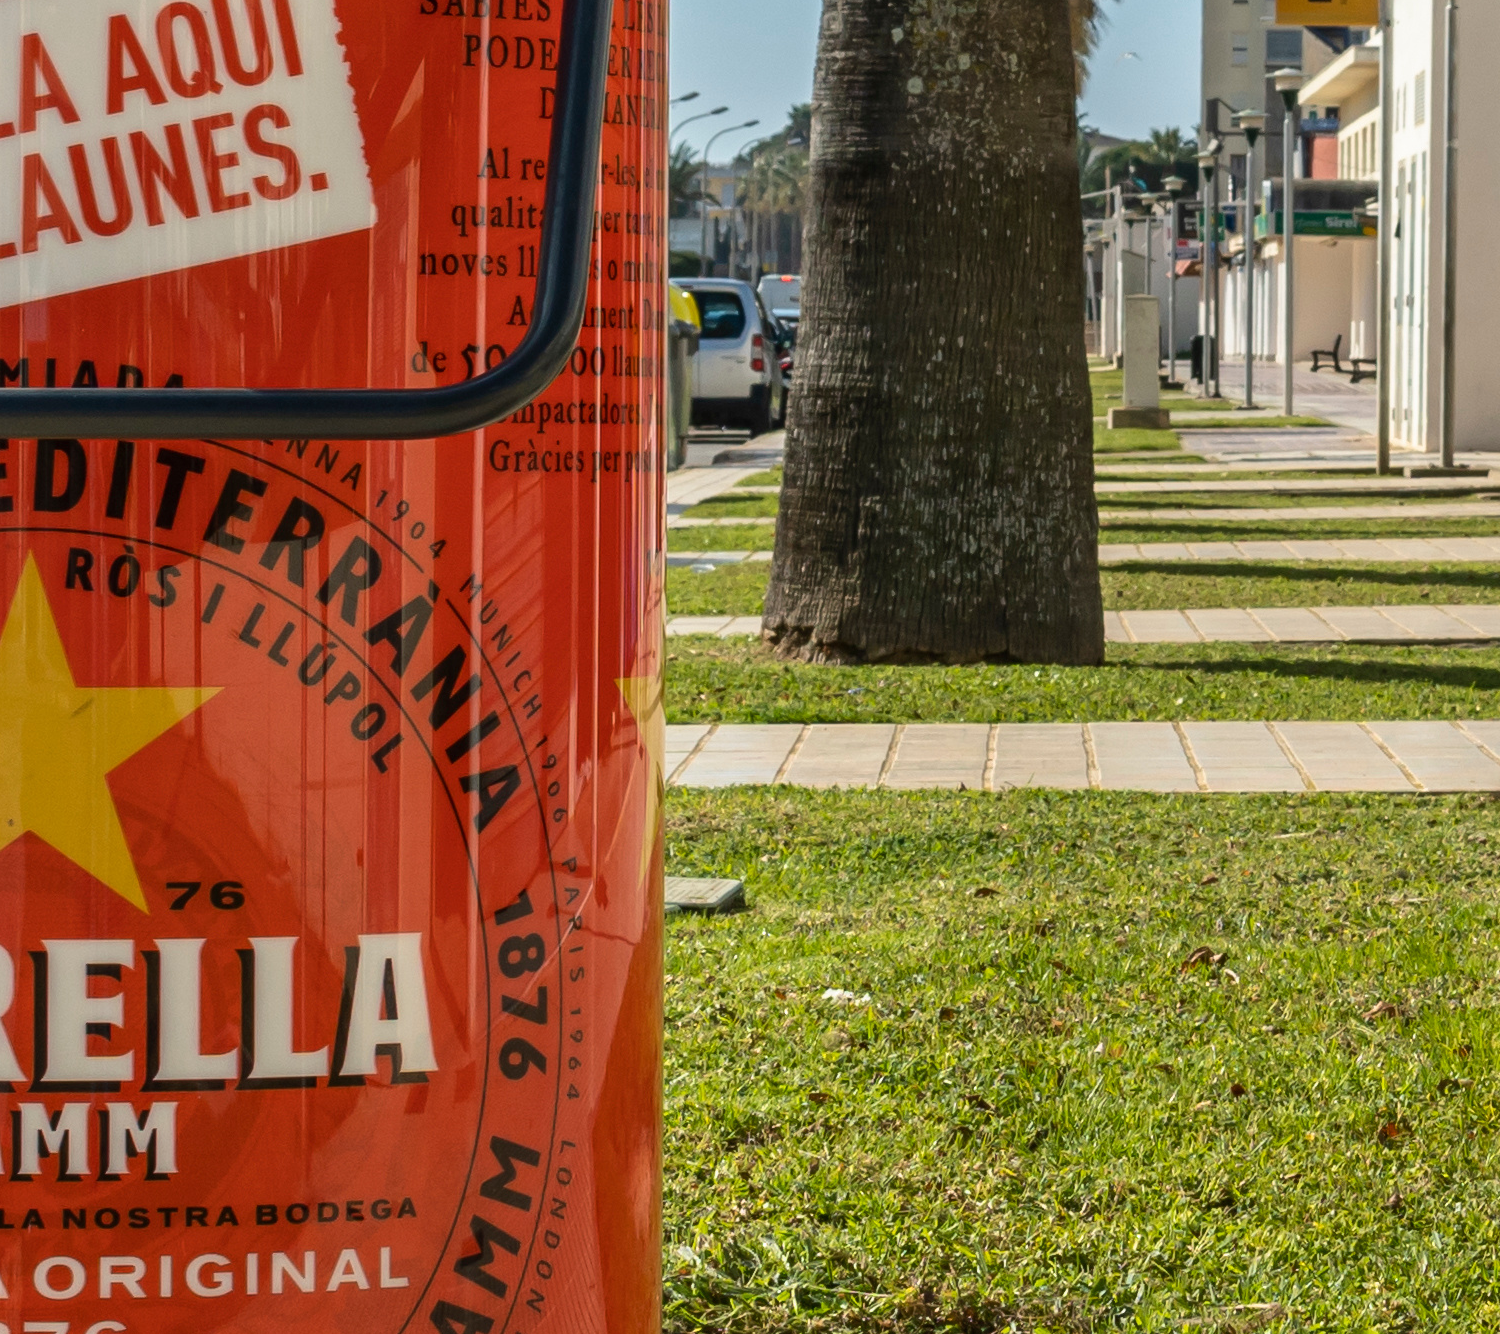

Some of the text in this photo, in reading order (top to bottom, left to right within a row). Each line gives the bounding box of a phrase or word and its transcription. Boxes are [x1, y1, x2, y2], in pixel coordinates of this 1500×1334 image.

[476, 147, 511, 180] Al
[419, 251, 508, 277] noves
[411, 341, 447, 374] de
[489, 439, 584, 473] Gràcies
[373, 488, 449, 561] 1904
[65, 543, 183, 609] RÒS
[201, 582, 226, 625] I
[237, 601, 406, 774] LLÚPOL
[459, 572, 544, 722] MUNICH
[531, 733, 569, 825] 1906
[164, 881, 246, 912] 76
[561, 855, 586, 984] PARIS
[494, 887, 549, 1081] 1876
[566, 1006, 585, 1101] 1964
[63, 1206, 240, 1230] NOSTRA
[254, 1197, 418, 1227] BODEGA
[525, 1138, 577, 1315] LONDON
[32, 1245, 410, 1300] ORIGINAL
